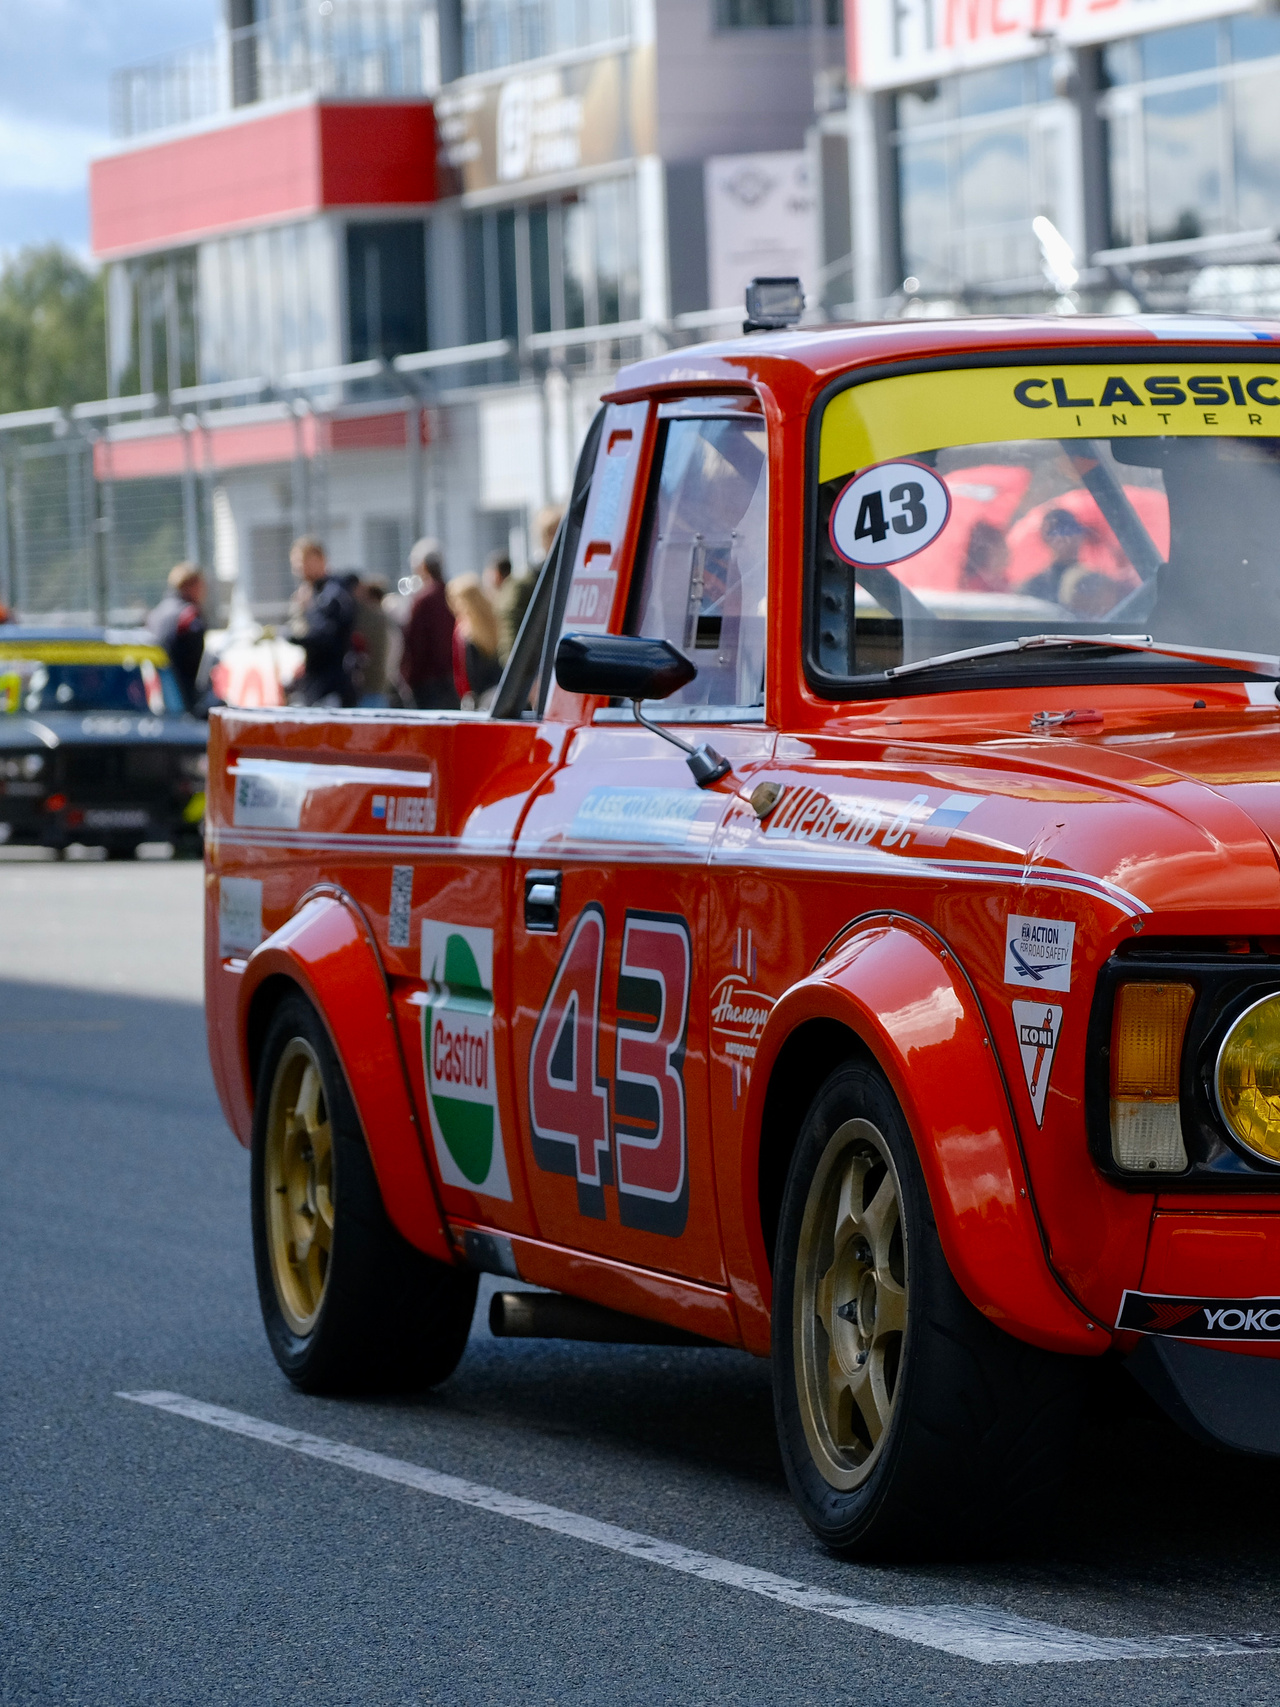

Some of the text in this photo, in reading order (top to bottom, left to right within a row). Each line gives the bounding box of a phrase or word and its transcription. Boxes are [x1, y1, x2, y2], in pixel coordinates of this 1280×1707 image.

[854, 482, 927, 543] 43
[765, 786, 883, 845] Шевель
[1020, 942, 1069, 961] FOR ROAD SAFETY
[1031, 926, 1059, 944] ACTION
[711, 984, 769, 1038] Наследи
[1021, 1028, 1051, 1045] KONI
[433, 1019, 489, 1089] Castrol
[529, 901, 692, 1237] 43
